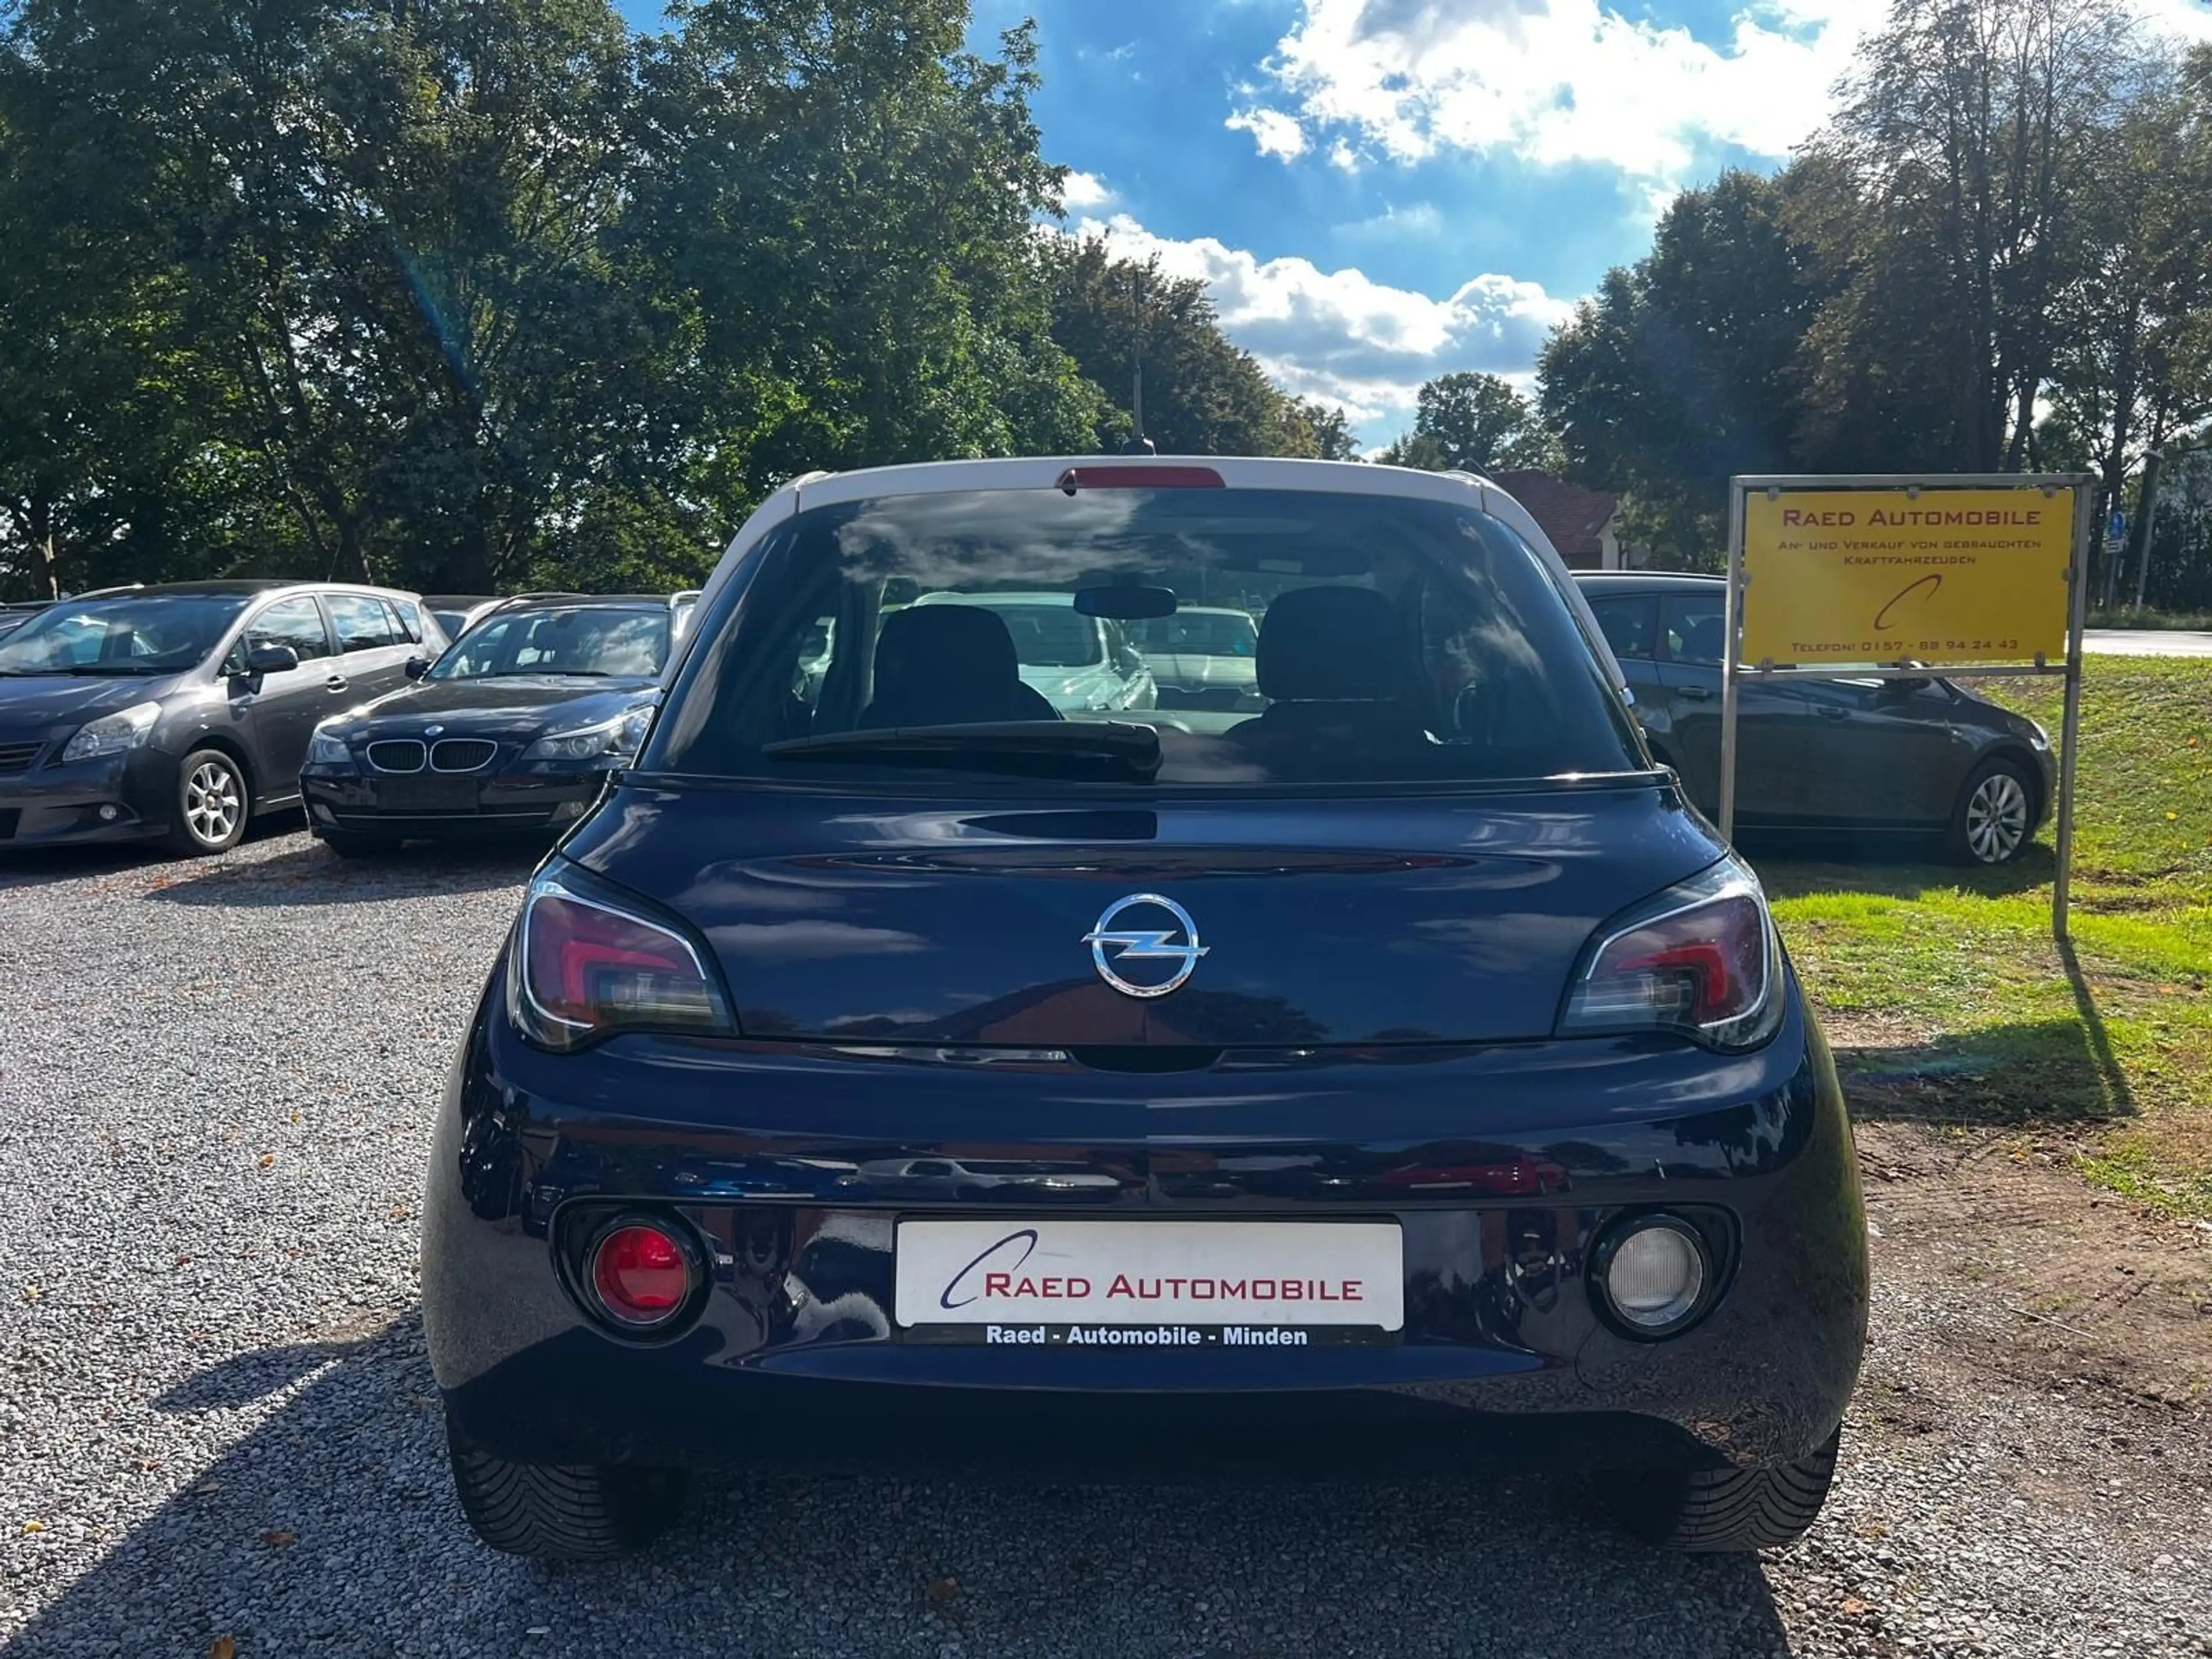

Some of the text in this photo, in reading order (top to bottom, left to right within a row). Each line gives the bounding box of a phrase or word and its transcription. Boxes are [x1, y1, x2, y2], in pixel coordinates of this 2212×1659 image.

[1783, 509, 2041, 527] RAED AUTOMOBILE
[1778, 540, 2041, 550] AN- UND VERKAUF VON GEBRAUCHTEN
[1844, 555, 1976, 565] KRAFTFAHRZEUGEN
[1861, 641, 1903, 652] 0157
[1919, 641, 1939, 650] 88
[1946, 641, 1965, 649] 94
[1972, 640, 1991, 649] 24
[1998, 639, 2018, 649] 43
[985, 1272, 1363, 1301] RAED AUTOMOBILE
[986, 1325, 1046, 1344] Raed
[1067, 1325, 1200, 1345] Automobile
[1223, 1327, 1308, 1346] Minden
